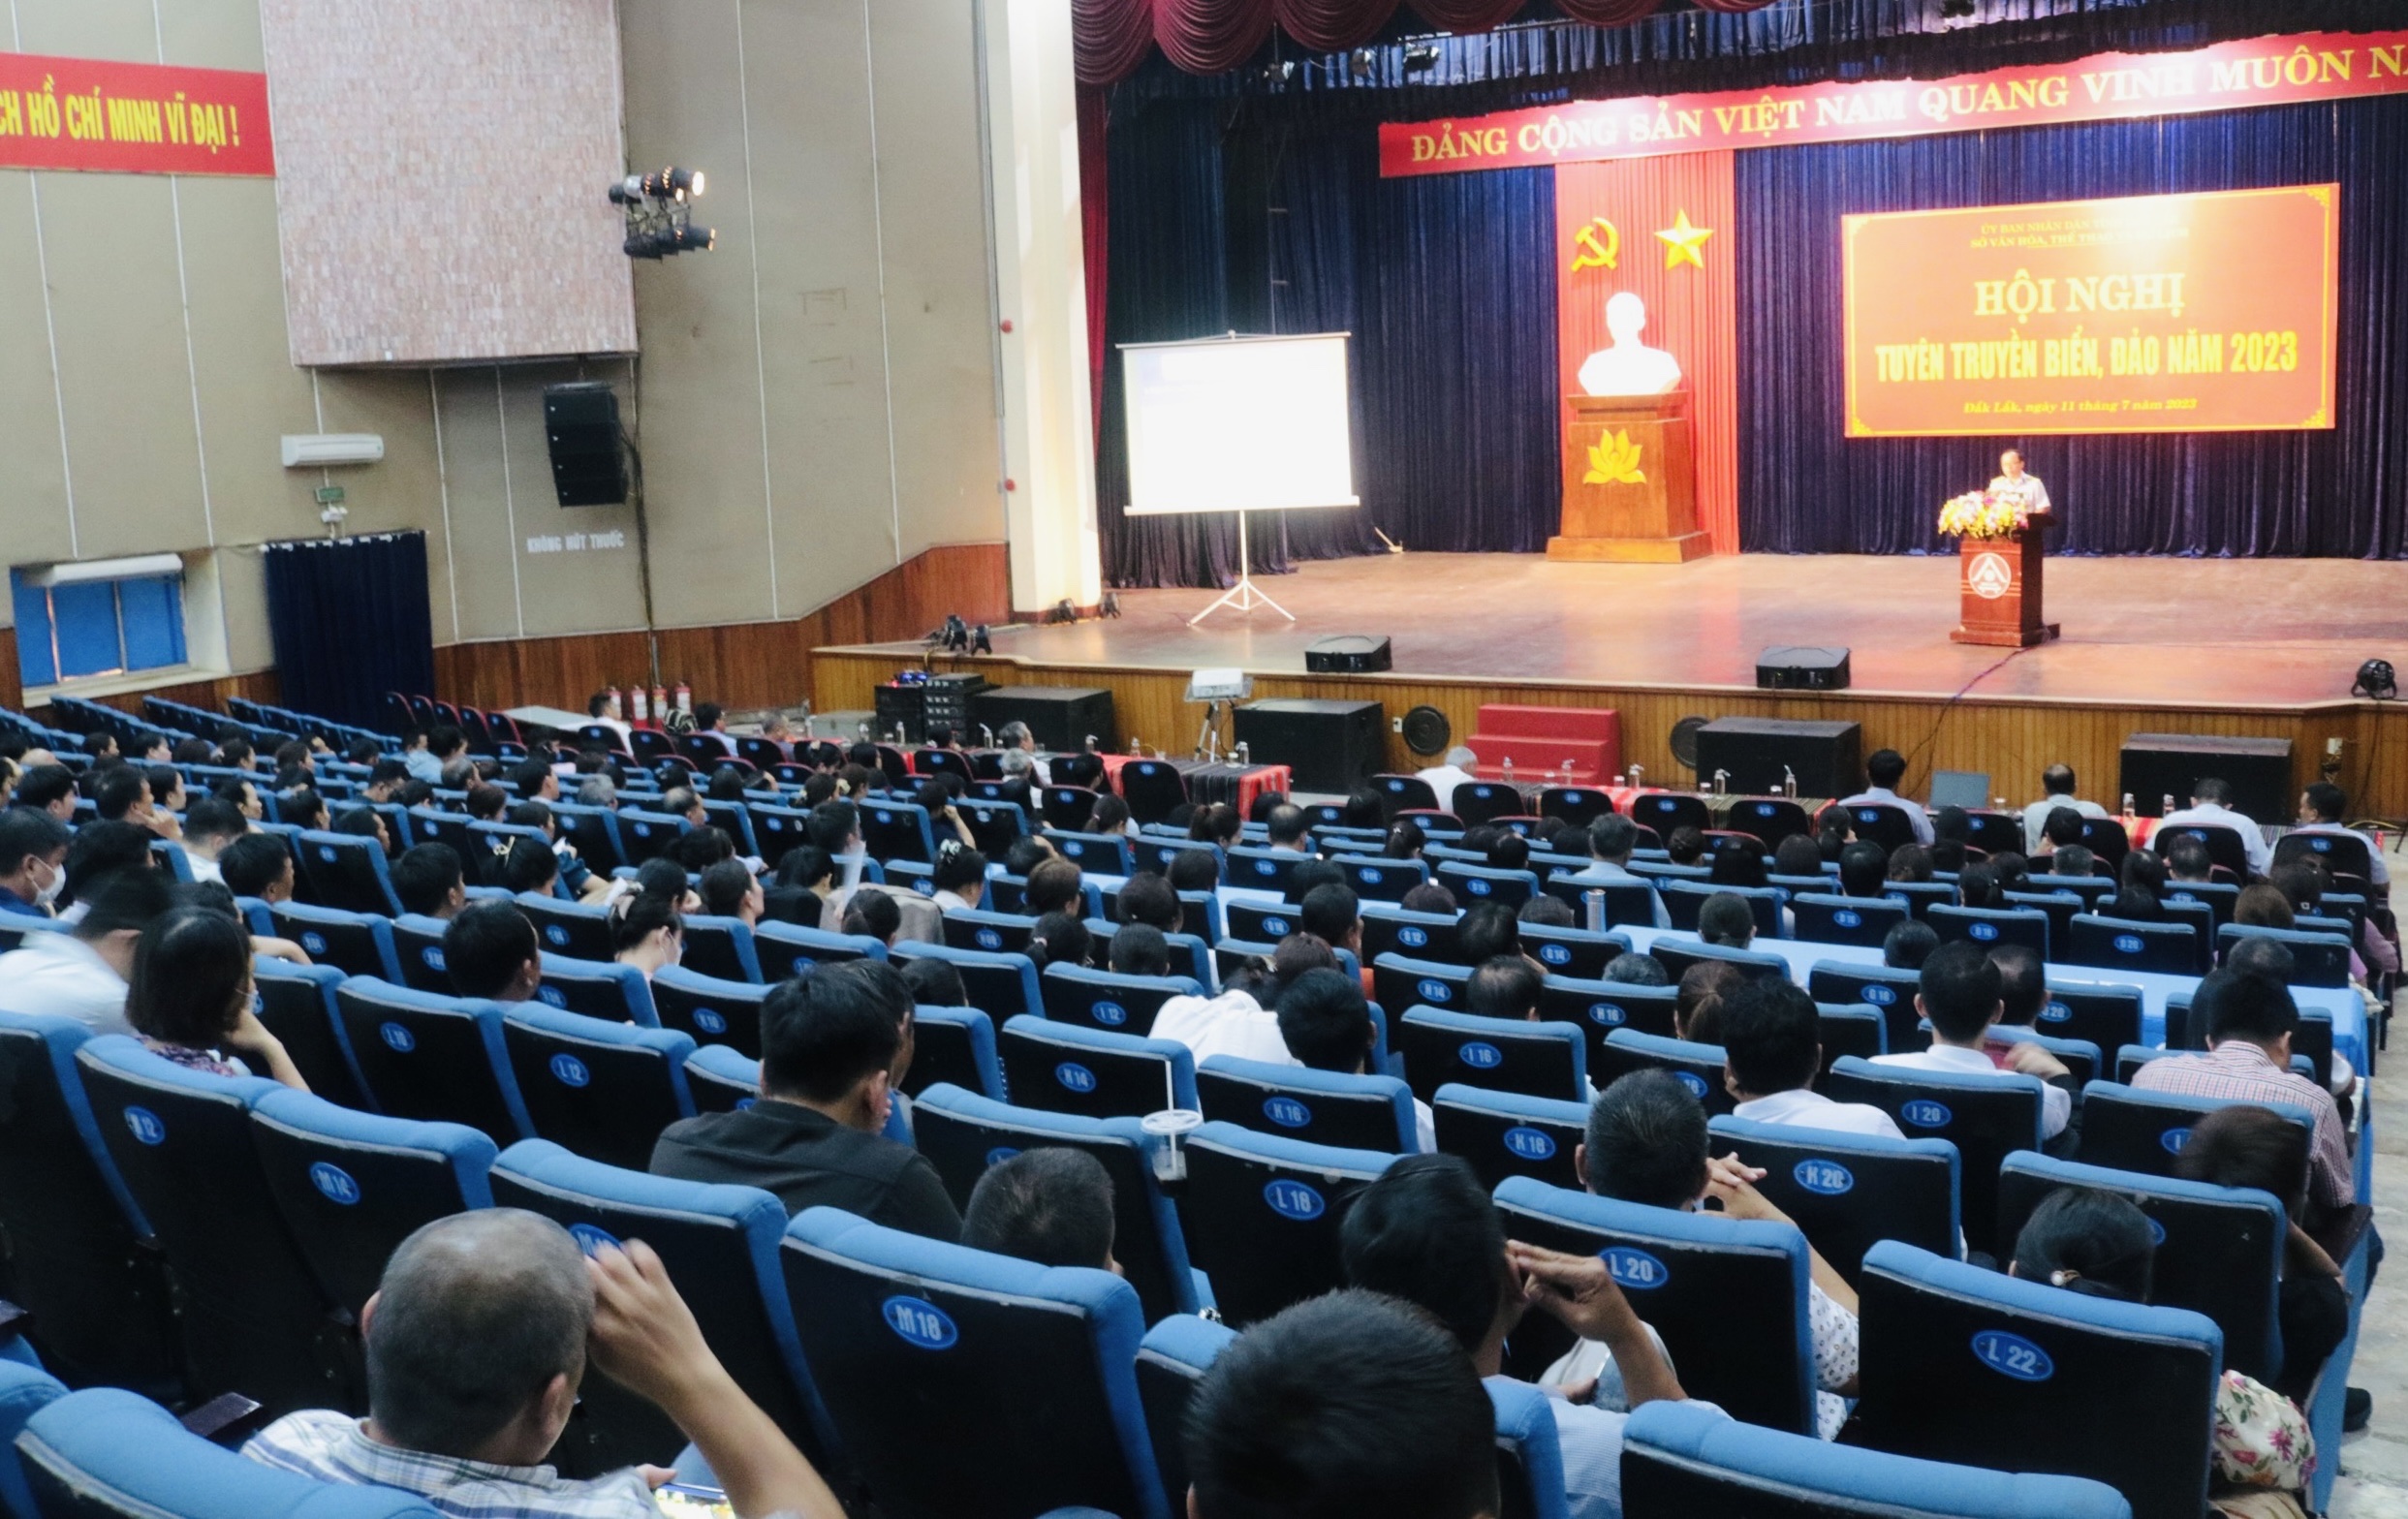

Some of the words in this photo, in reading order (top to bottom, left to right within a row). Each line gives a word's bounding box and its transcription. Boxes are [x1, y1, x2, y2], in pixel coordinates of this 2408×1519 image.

[26, 74, 61, 139] HỒ
[65, 85, 105, 140] CHÍ
[107, 97, 163, 143] MINH
[164, 91, 188, 144] VĨ
[190, 103, 227, 155] ĐẠI
[1412, 123, 1509, 163] ĐẢNG
[1518, 114, 1620, 157] CỘNG
[1629, 101, 1704, 143] SẢN
[1712, 96, 1805, 138] VIỆT
[1816, 88, 1906, 127] NAM
[1919, 76, 2070, 122] QUANG
[2080, 64, 2198, 102] VINH
[2209, 44, 2355, 93] MUÔN
[2367, 45, 2408, 78] N
[2000, 223, 2024, 233] BAN
[1974, 268, 2055, 324] HỘI
[2066, 272, 2185, 318] NGHỊ
[1875, 337, 1944, 383] TUYÊN
[1951, 327, 2037, 380] TRUYỀN
[2045, 325, 2104, 380] BIỂN,
[2111, 326, 2160, 376] ĐẢO
[2167, 328, 2223, 374] NĂM
[2230, 330, 2298, 373] 2023
[2025, 400, 2057, 415] ngày
[2079, 399, 2117, 414] tháng
[2121, 399, 2131, 411] 7
[1275, 1186, 1288, 1210] L
[1610, 1253, 1623, 1277] L
[1627, 1256, 1654, 1283] 20
[1987, 1337, 2001, 1362] L
[2006, 1345, 2036, 1375] 22
